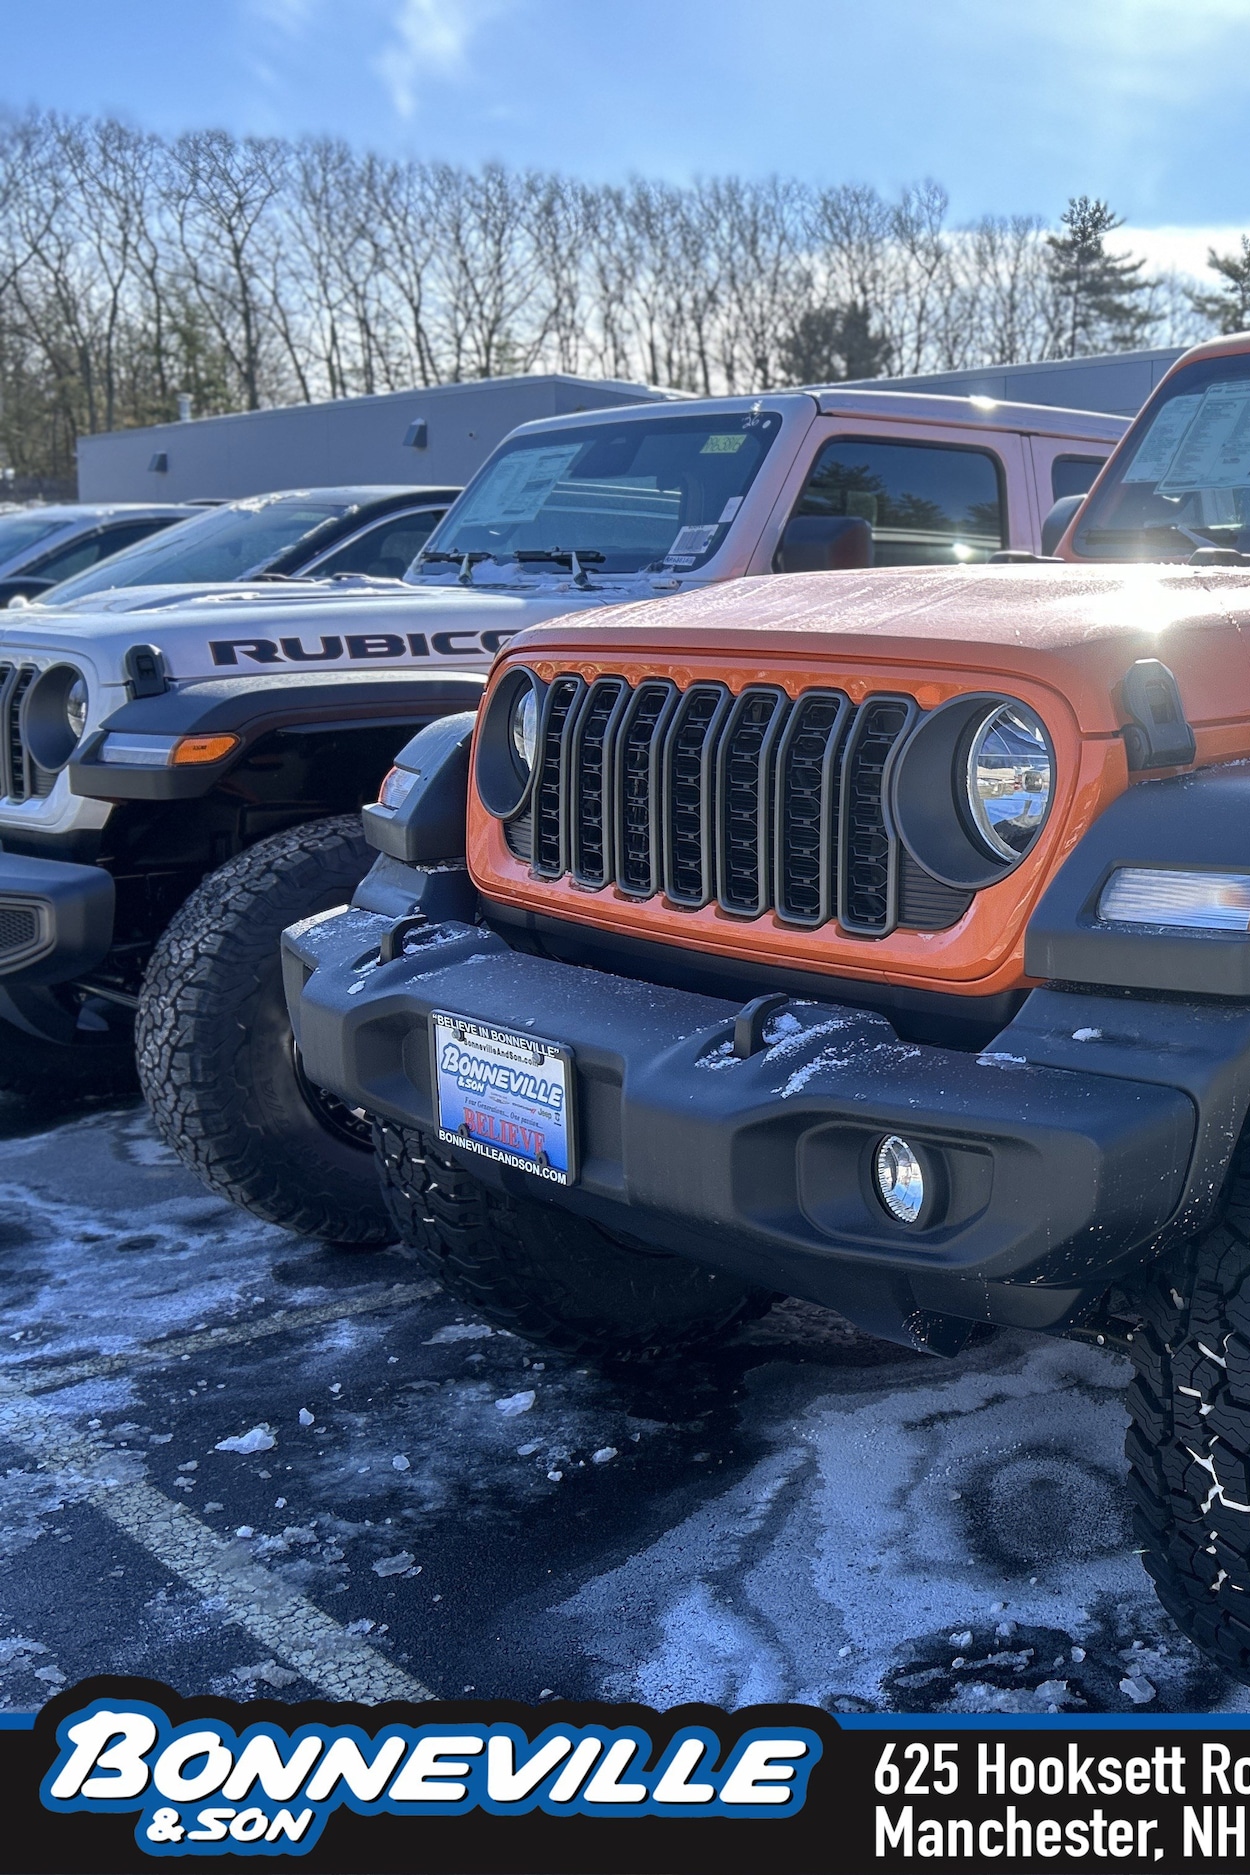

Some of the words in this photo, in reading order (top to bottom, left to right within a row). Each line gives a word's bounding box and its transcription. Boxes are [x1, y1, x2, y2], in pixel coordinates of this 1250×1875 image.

[208, 629, 523, 666] RUBICO
[478, 1026, 490, 1040] IN
[441, 1045, 563, 1107] BONNEVILLE
[457, 1076, 485, 1093] &SON
[463, 1106, 546, 1155] BELIEVE
[438, 1128, 568, 1186] BONNEVILLEANDSON.COM
